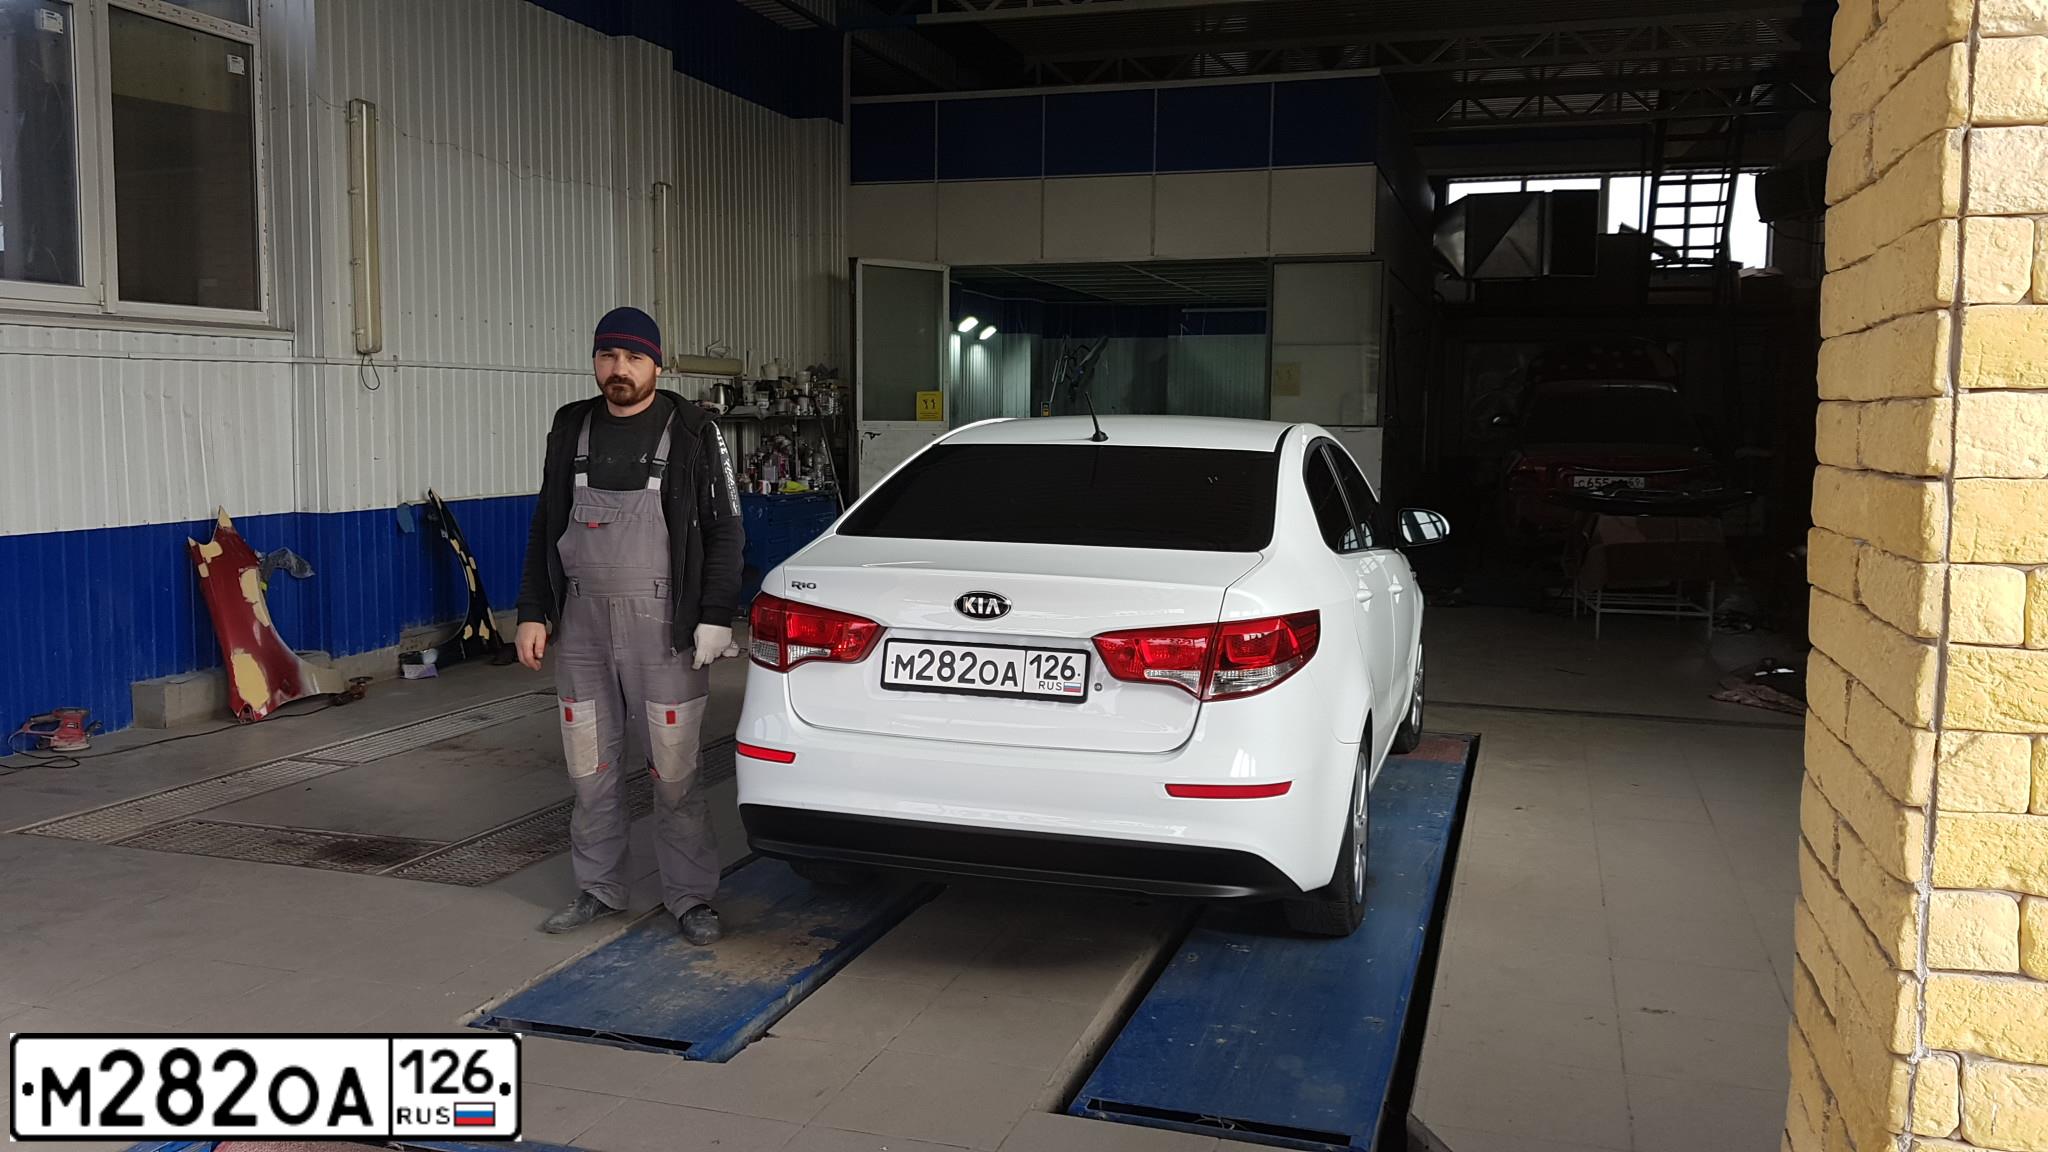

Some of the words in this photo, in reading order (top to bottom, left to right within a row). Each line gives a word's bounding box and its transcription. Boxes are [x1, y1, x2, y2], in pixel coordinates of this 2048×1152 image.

[962, 596, 1001, 615] KIA
[1029, 653, 1076, 681] 126
[1038, 680, 1062, 691] RUS
